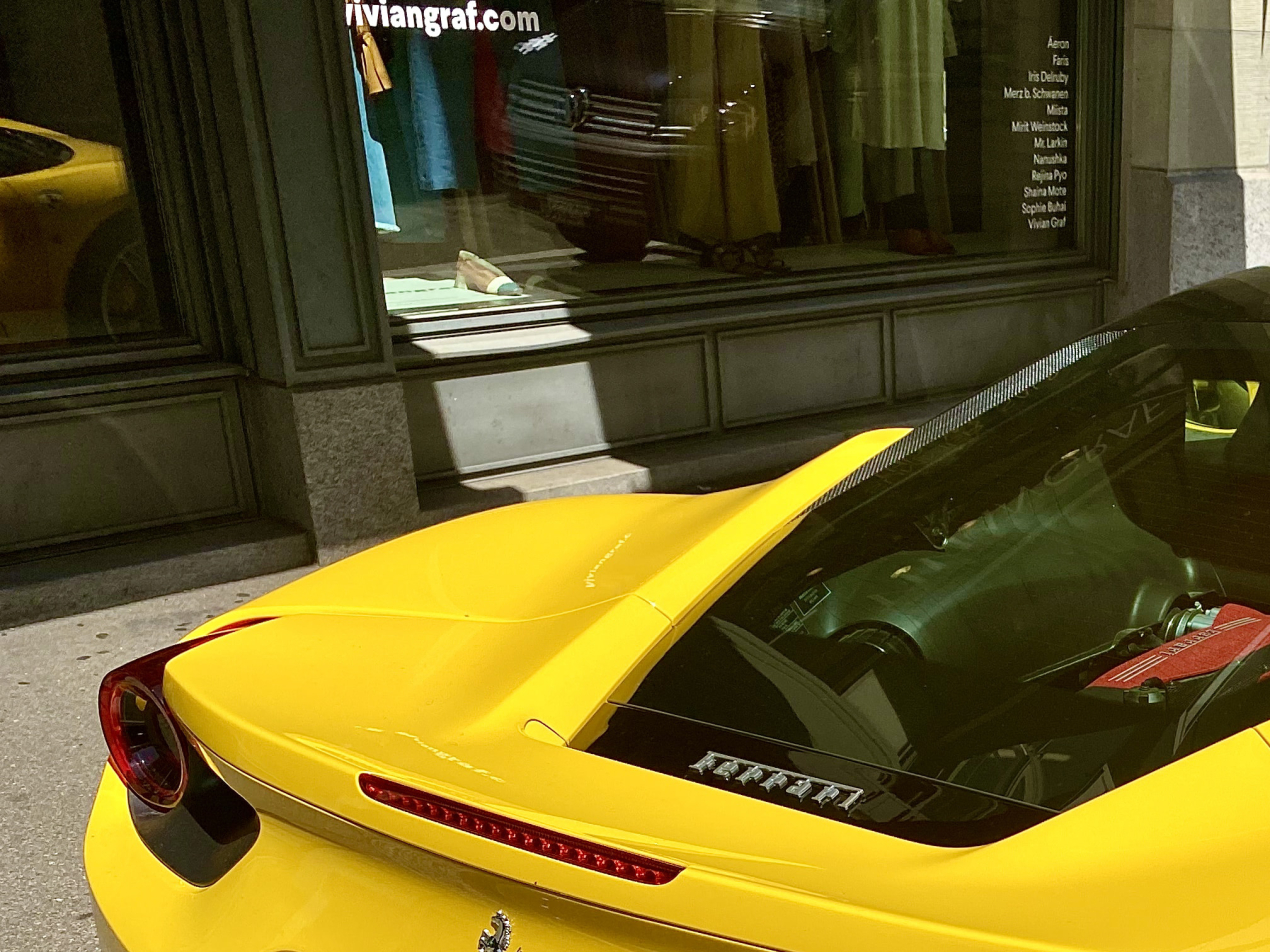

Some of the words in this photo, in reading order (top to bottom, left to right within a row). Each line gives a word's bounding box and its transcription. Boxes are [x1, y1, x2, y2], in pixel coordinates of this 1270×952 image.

[1028, 70, 1040, 82] Iris
[1003, 86, 1024, 98] Merz
[1030, 120, 1068, 132] Weinstock
[1046, 136, 1068, 148] Larkin
[1033, 153, 1068, 165] Nanushka
[1054, 169, 1068, 182] Pyo
[1023, 186, 1047, 198] Shaina
[1047, 186, 1067, 196] Mote
[1021, 202, 1046, 216] Sophie
[1028, 218, 1050, 229] Vivian
[1050, 216, 1067, 228] Graf
